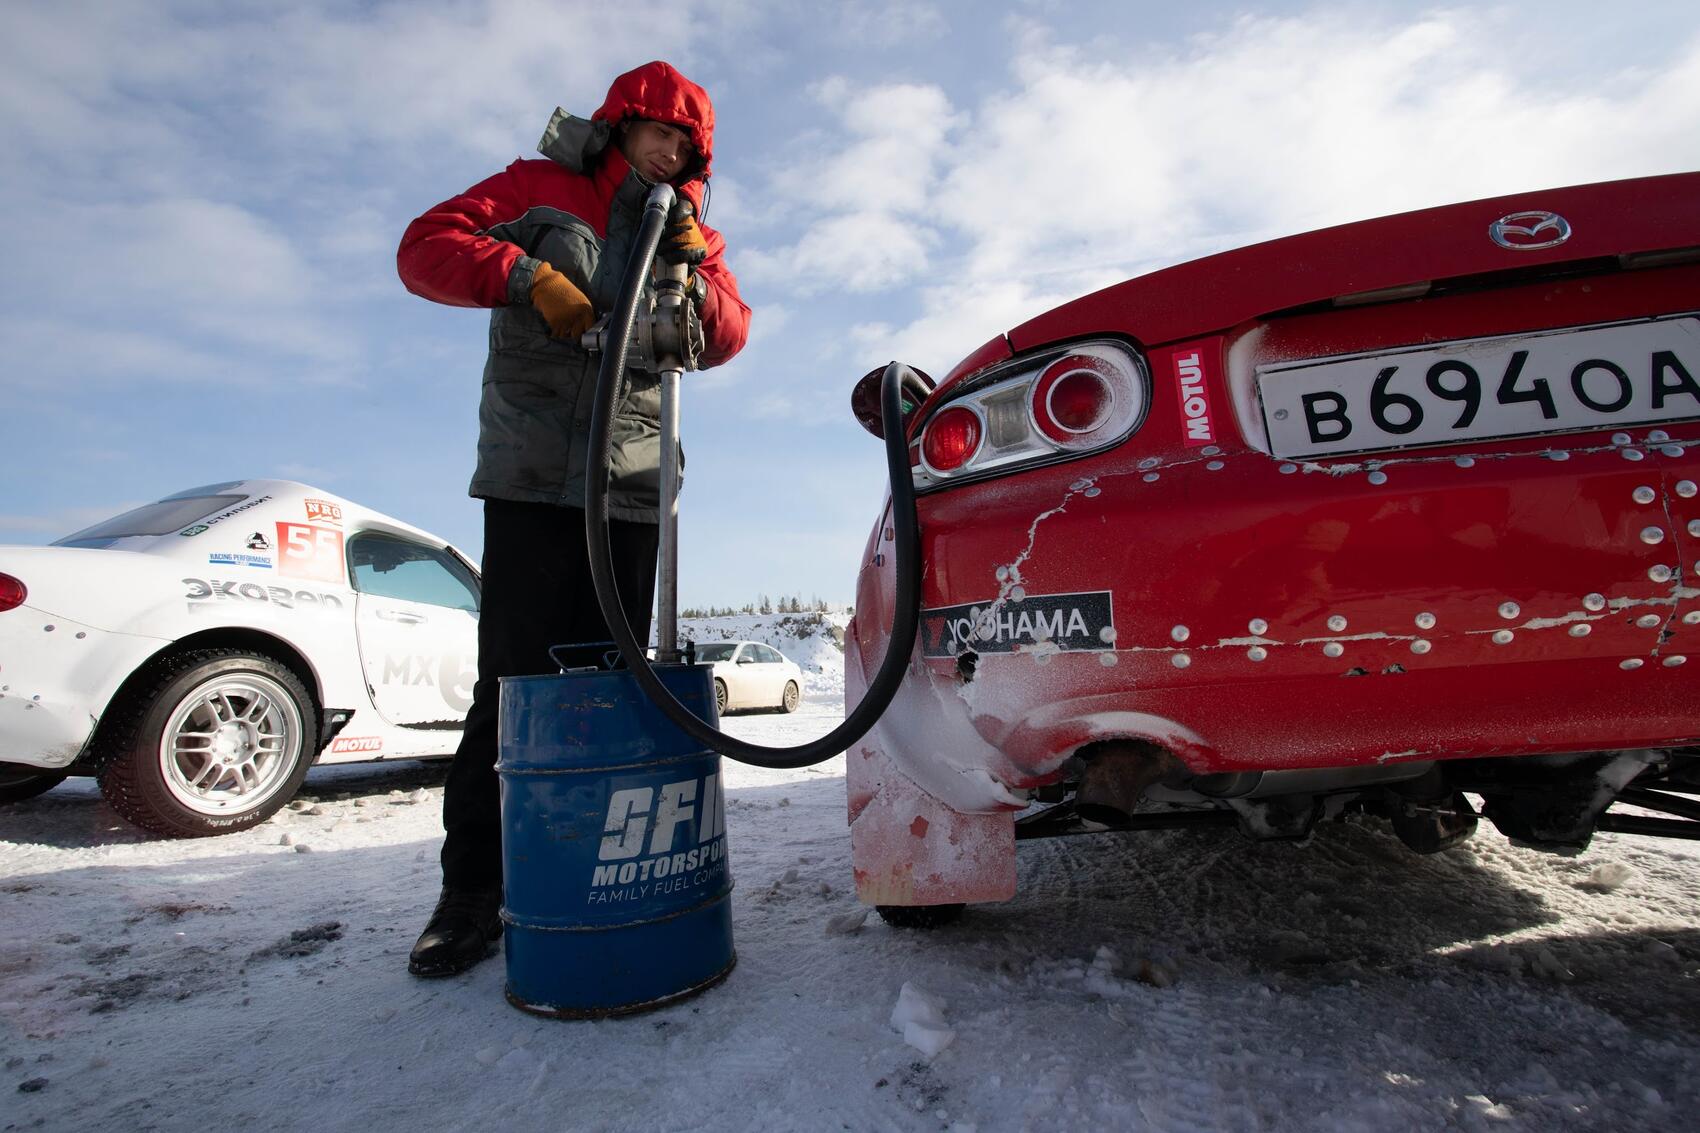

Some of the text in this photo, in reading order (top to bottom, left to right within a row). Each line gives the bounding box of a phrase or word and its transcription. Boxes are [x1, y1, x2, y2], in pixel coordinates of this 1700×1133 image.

[1178, 353, 1211, 440] MOTUL
[306, 502, 342, 520] NRG
[209, 553, 233, 561] RACING
[233, 554, 272, 564] PERFORMANCE
[335, 737, 383, 751] MOTUL
[587, 884, 650, 905] FAMILY
[653, 877, 690, 896] FUEL
